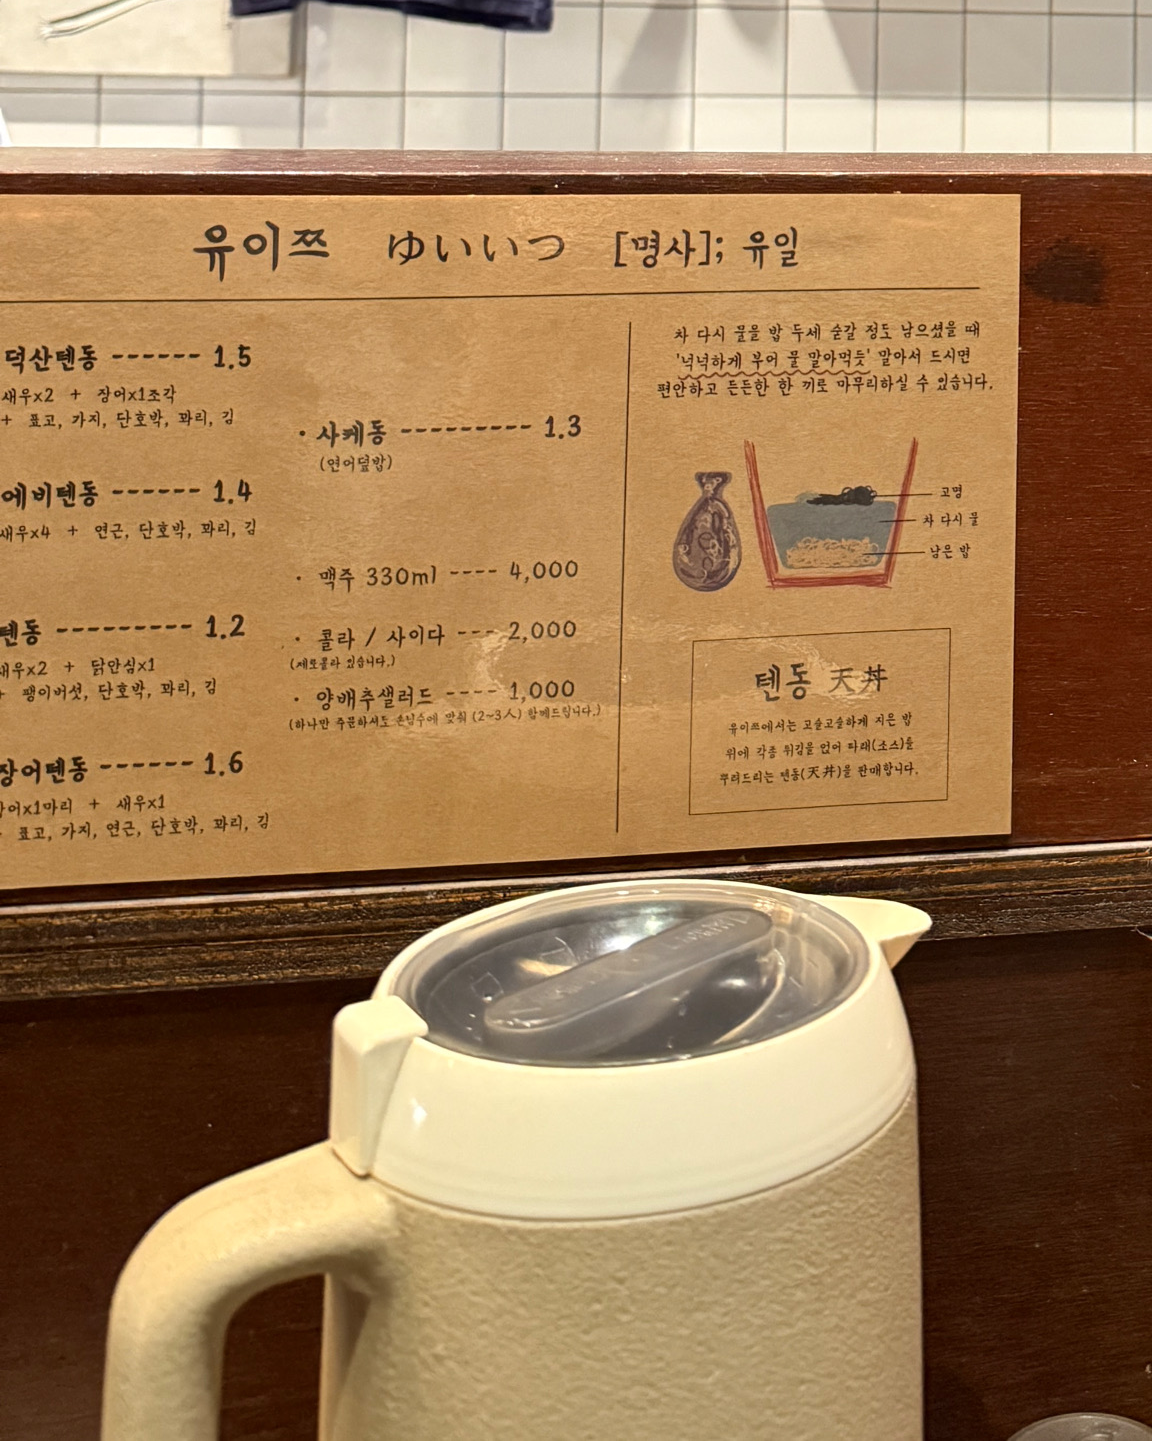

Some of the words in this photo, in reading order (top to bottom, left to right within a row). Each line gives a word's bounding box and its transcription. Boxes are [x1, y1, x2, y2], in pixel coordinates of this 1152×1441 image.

[192, 220, 331, 283] 유이쯔
[387, 229, 566, 266] ゆいいつ
[613, 228, 724, 269] [명사];
[741, 225, 799, 271] 유일
[673, 325, 690, 345] 차
[697, 324, 725, 344] 다시
[733, 324, 761, 343] 물을
[768, 322, 784, 343] 밥
[791, 322, 821, 343] 두세
[864, 320, 893, 341] 정도
[900, 320, 957, 339] 남으셨을
[964, 320, 980, 339] 때
[4, 344, 99, 375] 덕산텐동
[213, 343, 252, 371] 1.5
[751, 350, 778, 371] 부어
[786, 349, 800, 369] 물
[877, 347, 921, 367] 말아서
[929, 346, 971, 365] 드시면
[656, 378, 719, 399] 편안하고
[726, 377, 770, 398] 든든한
[777, 377, 794, 397] 한
[801, 376, 829, 394] 끼로
[836, 373, 909, 394] 마무리하실
[915, 373, 930, 393] 수
[936, 371, 994, 392] 있습니다.
[28, 413, 63, 430] 표고,
[71, 410, 107, 429] 가지,
[116, 408, 169, 429] 단호박,
[177, 408, 213, 428] 꽈리,
[221, 407, 234, 426] 김
[315, 419, 388, 449] 사케동
[544, 414, 582, 440] 1.3
[319, 453, 393, 473] (연어덮밥)
[0, 480, 99, 511] 에비텐동
[212, 478, 253, 505] 1.4
[940, 483, 963, 500] 고명
[94, 521, 130, 541] 연근,
[138, 519, 192, 540] 단호박,
[200, 519, 236, 539] 꽈리,
[244, 517, 257, 536] 김
[922, 512, 935, 529] 차
[940, 511, 963, 528] 다시
[968, 511, 979, 527] 물
[929, 543, 953, 560] 남은
[958, 542, 972, 560] 밥
[318, 565, 356, 594] 맥주
[366, 564, 437, 587] 330ml
[509, 559, 579, 584] 4,000
[205, 613, 246, 641] 1.2
[317, 627, 356, 652] 콜라
[385, 623, 446, 649] 사이다
[508, 619, 577, 644] 2,000
[21, 681, 89, 703] 팽이버섯,
[98, 679, 152, 701] 단호박,
[160, 678, 196, 698] 꽈리,
[204, 677, 217, 696] 김
[316, 684, 434, 712] 양배추샐러드
[509, 679, 575, 704] 1,000
[754, 662, 812, 703] 텐동
[802, 713, 869, 731] 고슬고슬하게
[874, 712, 897, 728] 지은
[901, 711, 913, 727] 밥
[203, 750, 244, 777] 1.6
[725, 745, 750, 761] 위에
[756, 743, 778, 760] 각종
[782, 741, 815, 758] 튀김을
[857, 761, 919, 778] 판매합니다.
[17, 826, 53, 842] 표고,
[61, 821, 98, 841] 가지,
[106, 819, 142, 838] 연근,
[150, 815, 205, 837] 단호박,
[212, 813, 249, 833] 꽈리,
[257, 811, 269, 830] 김
